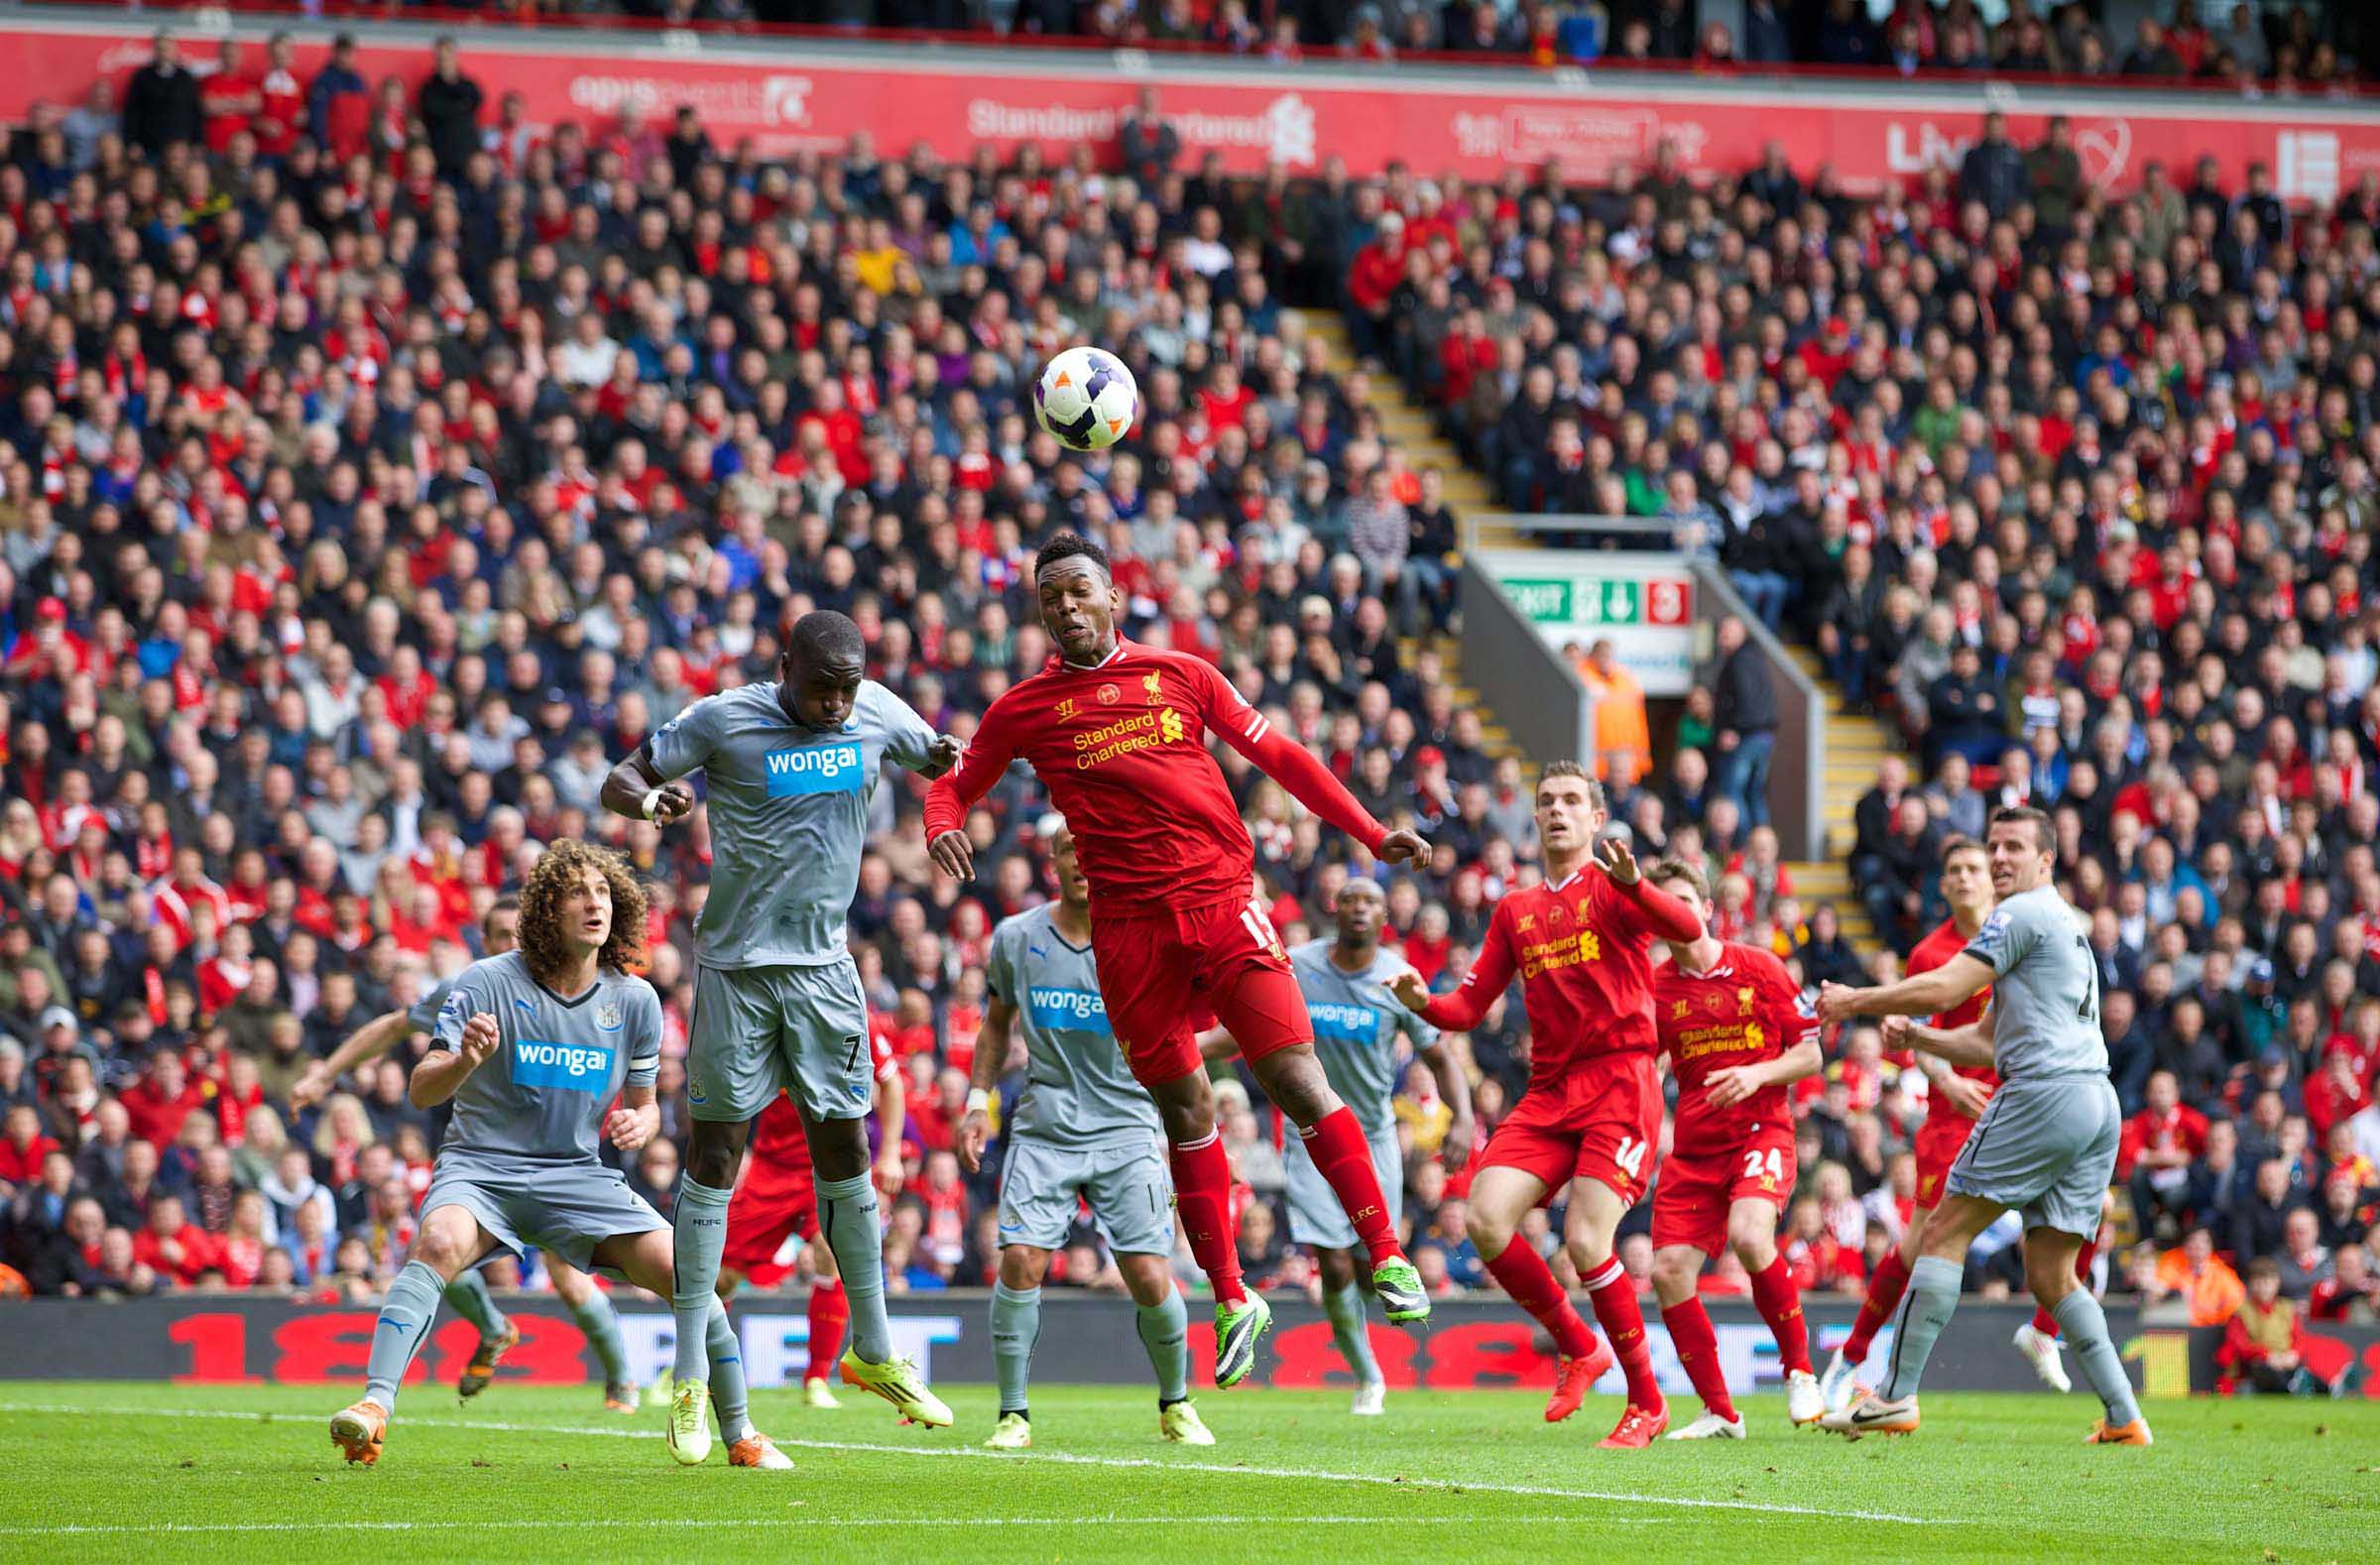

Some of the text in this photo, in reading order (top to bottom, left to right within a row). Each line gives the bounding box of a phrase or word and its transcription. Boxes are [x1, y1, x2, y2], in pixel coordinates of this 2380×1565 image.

[1120, 104, 1277, 147] rtered
[1073, 711, 1155, 751] Standard
[1076, 730, 1160, 770] Chartered
[1031, 991, 1106, 1019] wonga
[1680, 1023, 1743, 1045] Standard
[1682, 1038, 1746, 1059] Chartered
[518, 1044, 600, 1076] wonga
[844, 1033, 862, 1078] 7
[1614, 1136, 1647, 1178] 14
[1743, 1147, 1782, 1180] 24
[693, 1218, 722, 1228] NUFC
[859, 1203, 879, 1215] NUF
